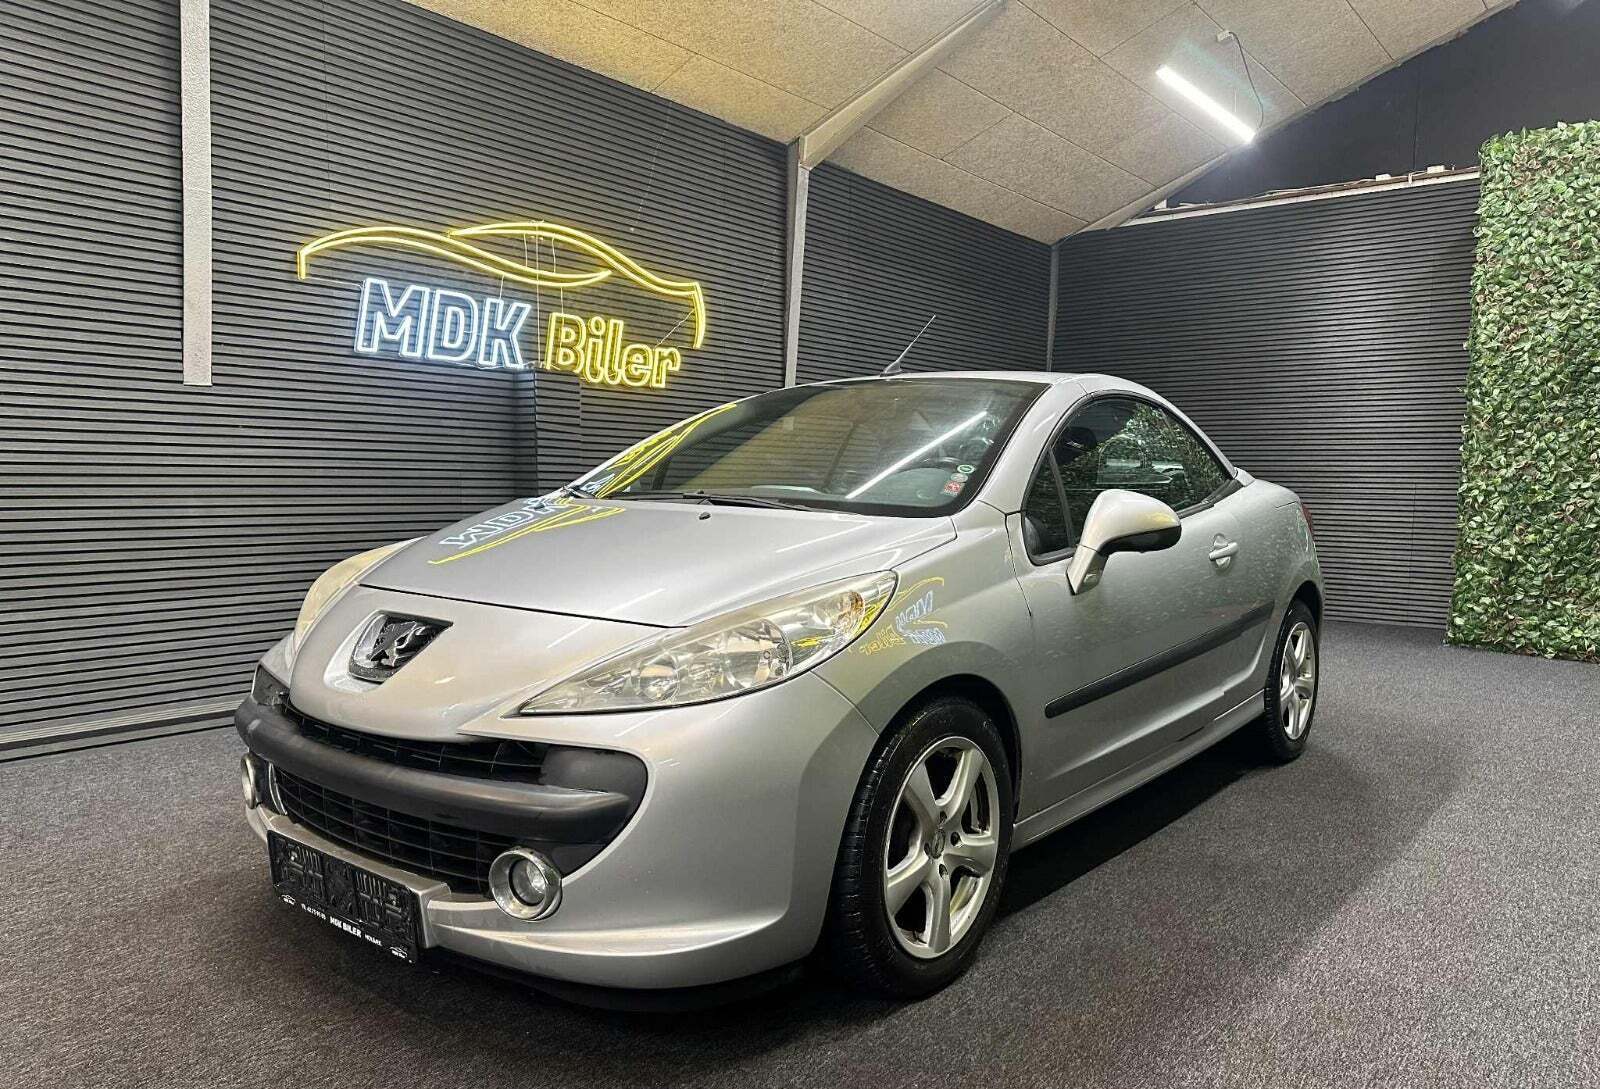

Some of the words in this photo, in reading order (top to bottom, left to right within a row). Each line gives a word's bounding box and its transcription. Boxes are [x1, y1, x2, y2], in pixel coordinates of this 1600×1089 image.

[353, 277, 531, 369] MDK
[545, 312, 681, 388] Biler
[342, 922, 362, 938] BILER
